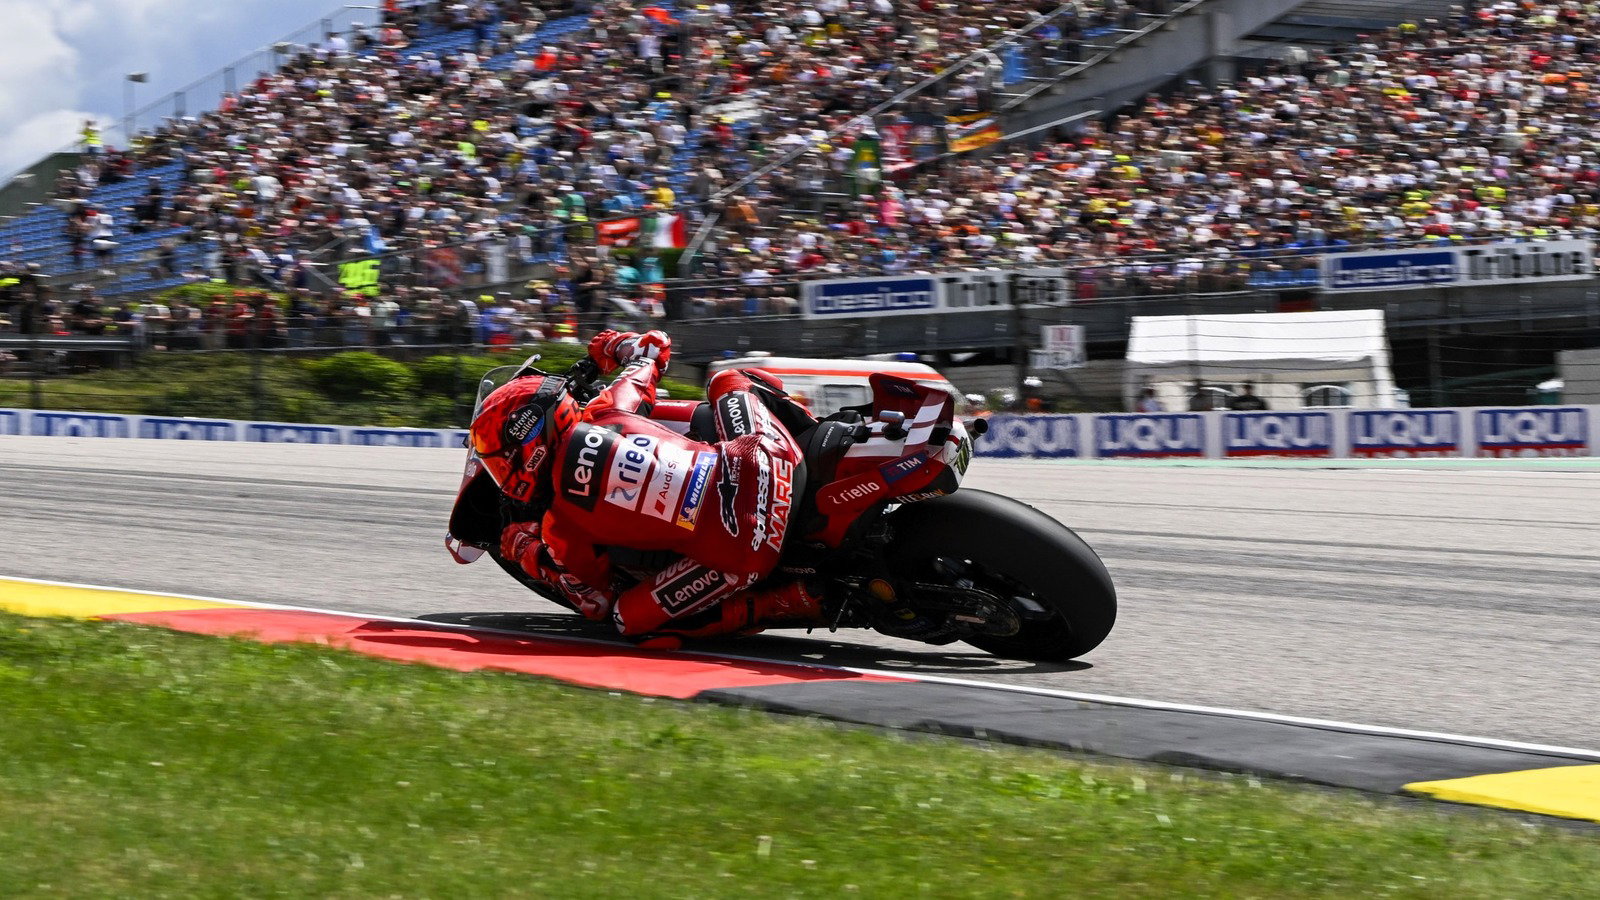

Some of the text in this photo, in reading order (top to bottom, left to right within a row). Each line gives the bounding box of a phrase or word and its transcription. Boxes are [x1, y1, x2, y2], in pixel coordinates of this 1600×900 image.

[509, 409, 533, 436] Estrella
[516, 415, 539, 440] Galicia
[726, 397, 746, 435] enovo
[527, 449, 545, 470] SHOEI
[618, 437, 651, 484] rieo
[896, 457, 922, 471] TIM
[659, 470, 674, 499] Audi
[840, 482, 880, 502] riello
[766, 455, 793, 553] MARC
[663, 569, 720, 607] Lenovo
